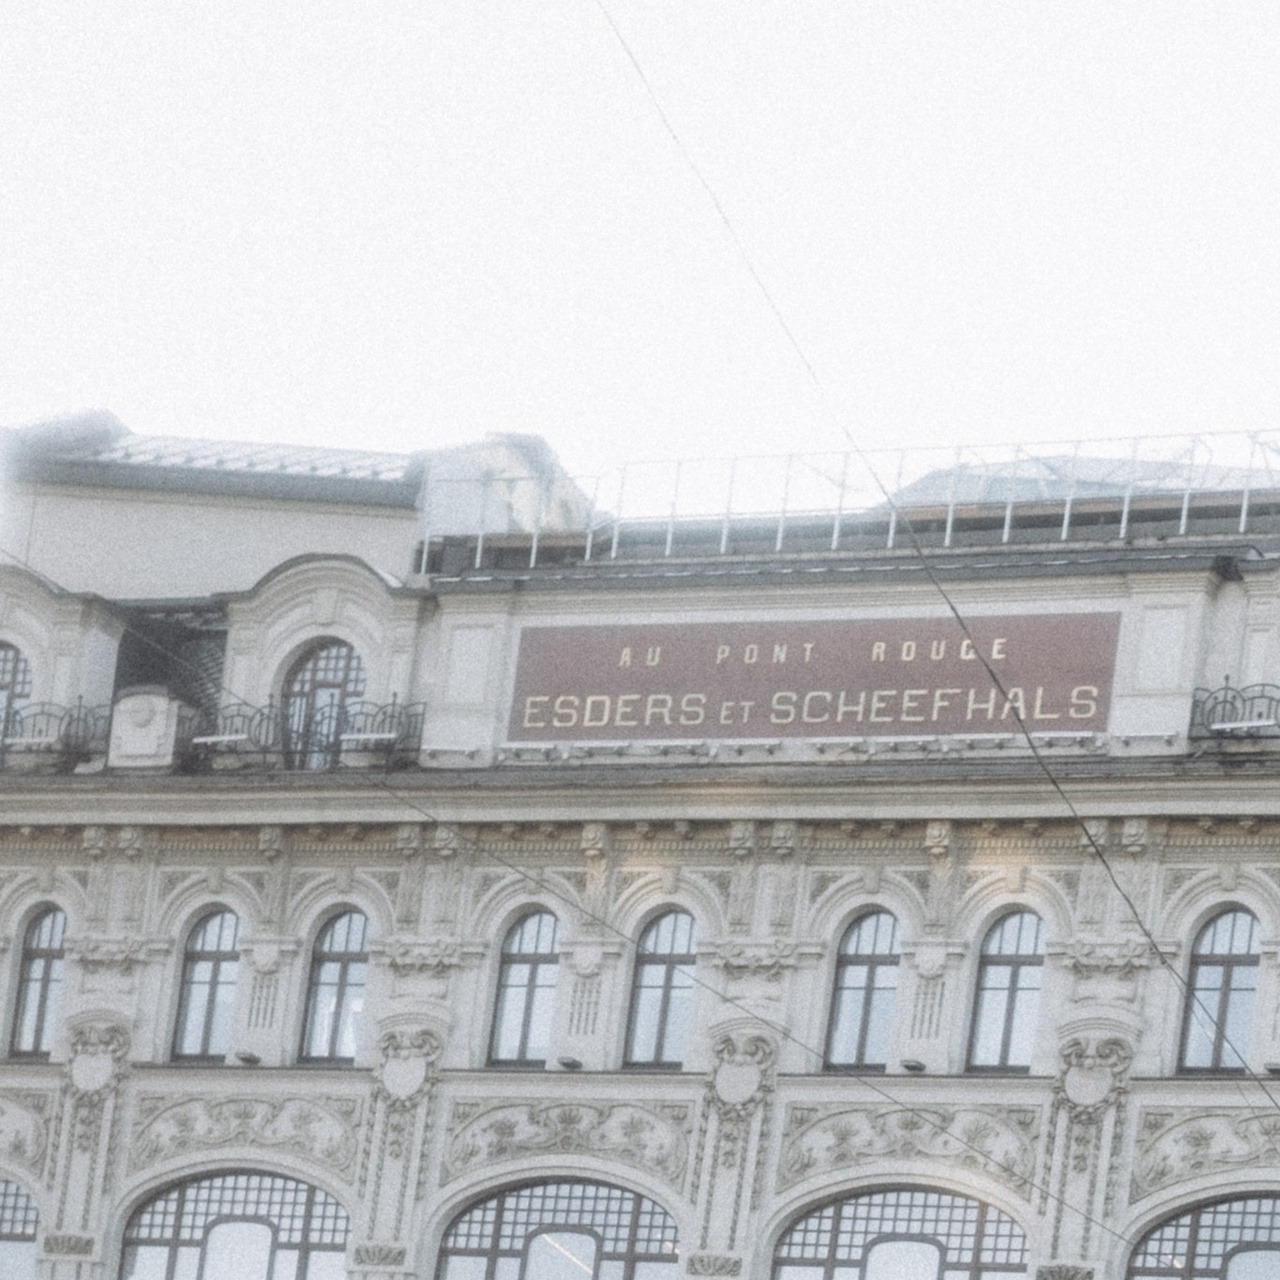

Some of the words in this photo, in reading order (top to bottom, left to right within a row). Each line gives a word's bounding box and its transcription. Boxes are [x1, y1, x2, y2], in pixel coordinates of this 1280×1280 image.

[619, 646, 662, 668] AU
[716, 642, 817, 665] PONT
[872, 638, 1007, 662] ROUGE
[523, 693, 706, 729] ESDERS
[719, 700, 756, 725] ET
[769, 684, 1099, 724] SCHEEFHALS
